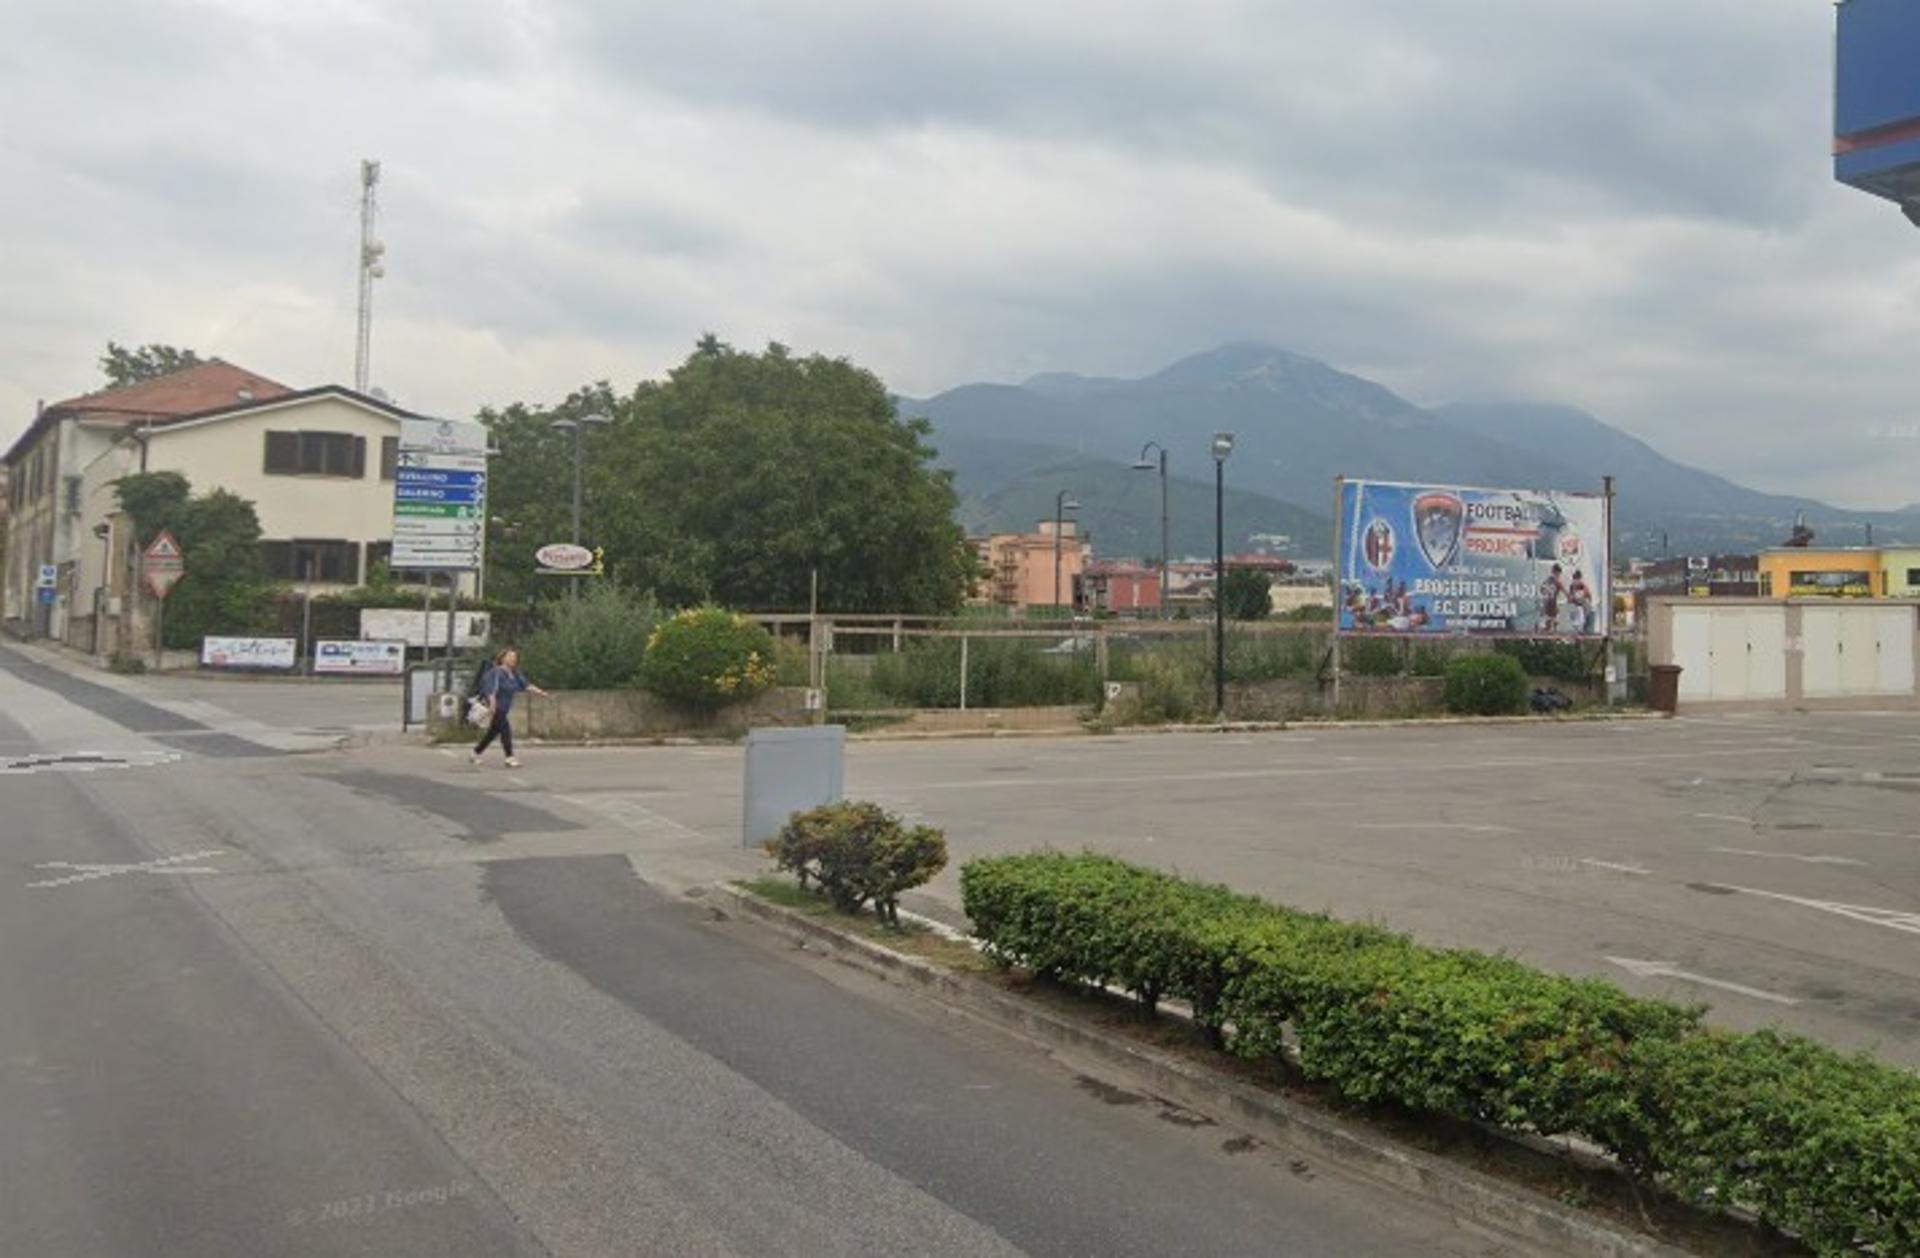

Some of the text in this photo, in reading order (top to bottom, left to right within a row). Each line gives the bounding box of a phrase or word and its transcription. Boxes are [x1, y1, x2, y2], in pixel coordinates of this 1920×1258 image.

[1415, 578, 1480, 597] PROGETTO
[1484, 581, 1537, 599] TECNICO
[1458, 601, 1517, 618] BOLOGNA
